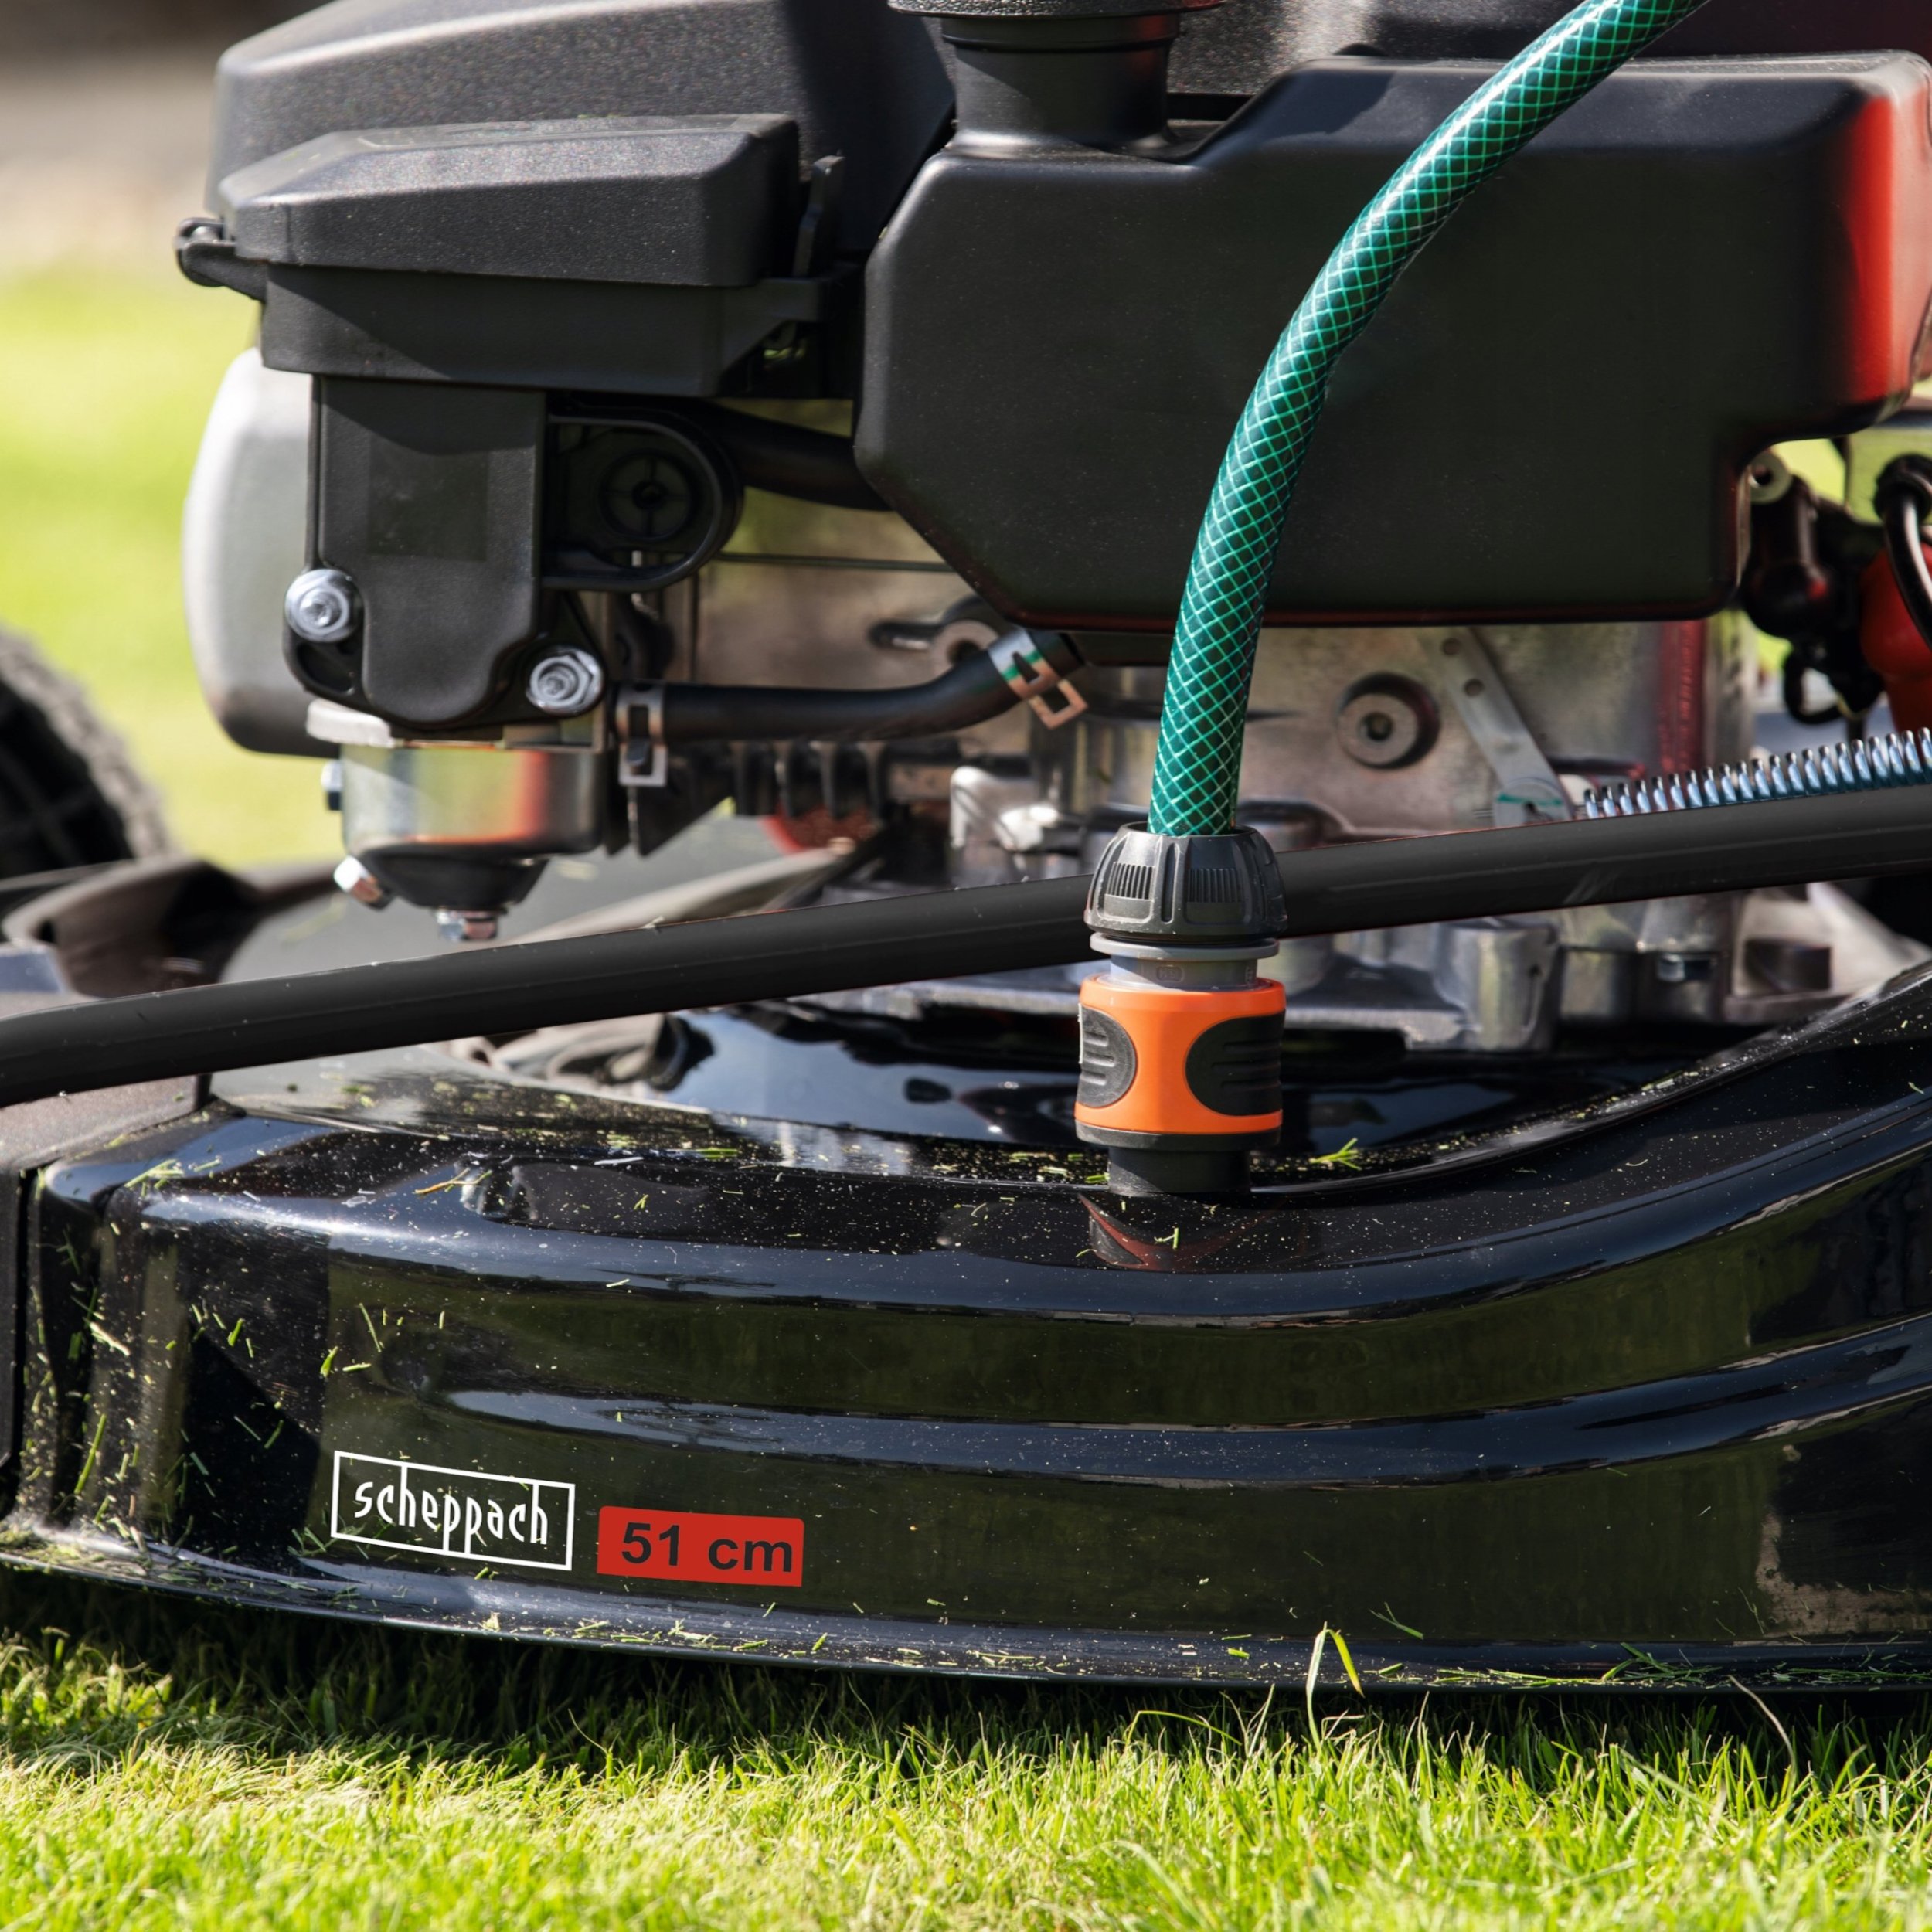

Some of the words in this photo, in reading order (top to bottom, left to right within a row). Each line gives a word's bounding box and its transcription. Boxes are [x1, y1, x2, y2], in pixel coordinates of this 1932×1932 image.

[353, 1463, 549, 1554] scheppach
[621, 1522, 679, 1566] 51
[708, 1538, 793, 1573] cm
